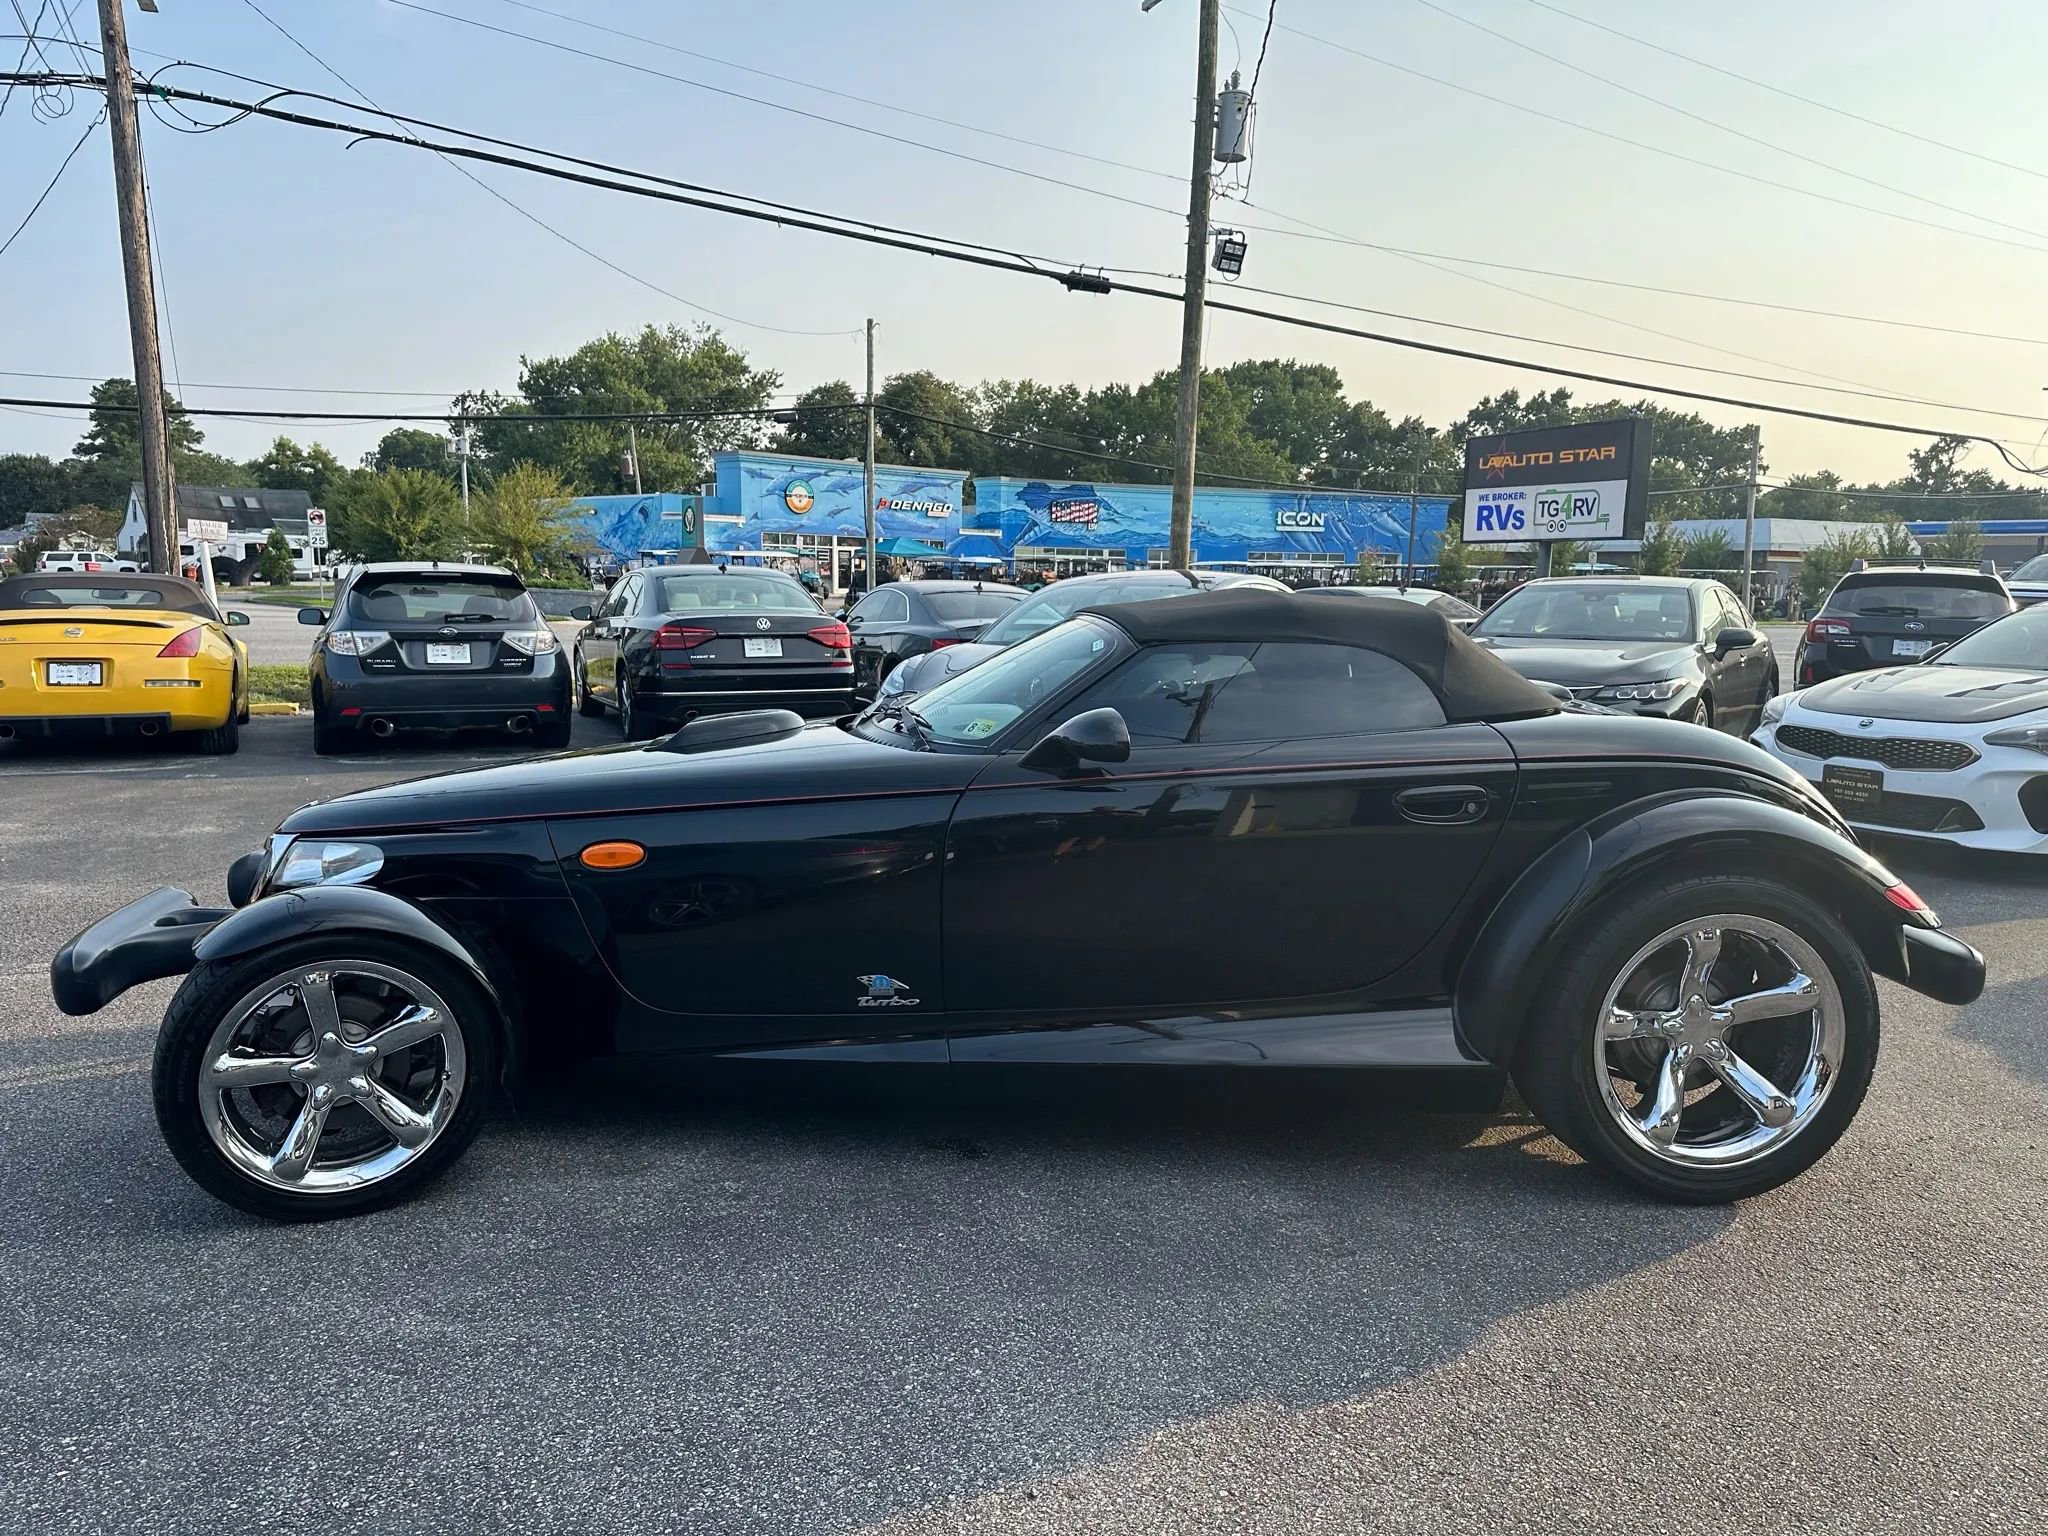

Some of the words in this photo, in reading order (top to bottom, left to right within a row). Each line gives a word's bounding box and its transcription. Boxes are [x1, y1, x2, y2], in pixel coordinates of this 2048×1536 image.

[1559, 446, 1616, 463] STAR
[1479, 493, 1490, 502] WE
[1492, 491, 1527, 501] BROKER:
[890, 500, 953, 513] DENAGO
[1538, 494, 1597, 520] TG4RV
[1276, 511, 1325, 526] ICON
[1476, 503, 1525, 531] RVs
[311, 536, 326, 545] 25
[1857, 782, 1879, 790] STAR
[857, 995, 920, 1007] Turbo
